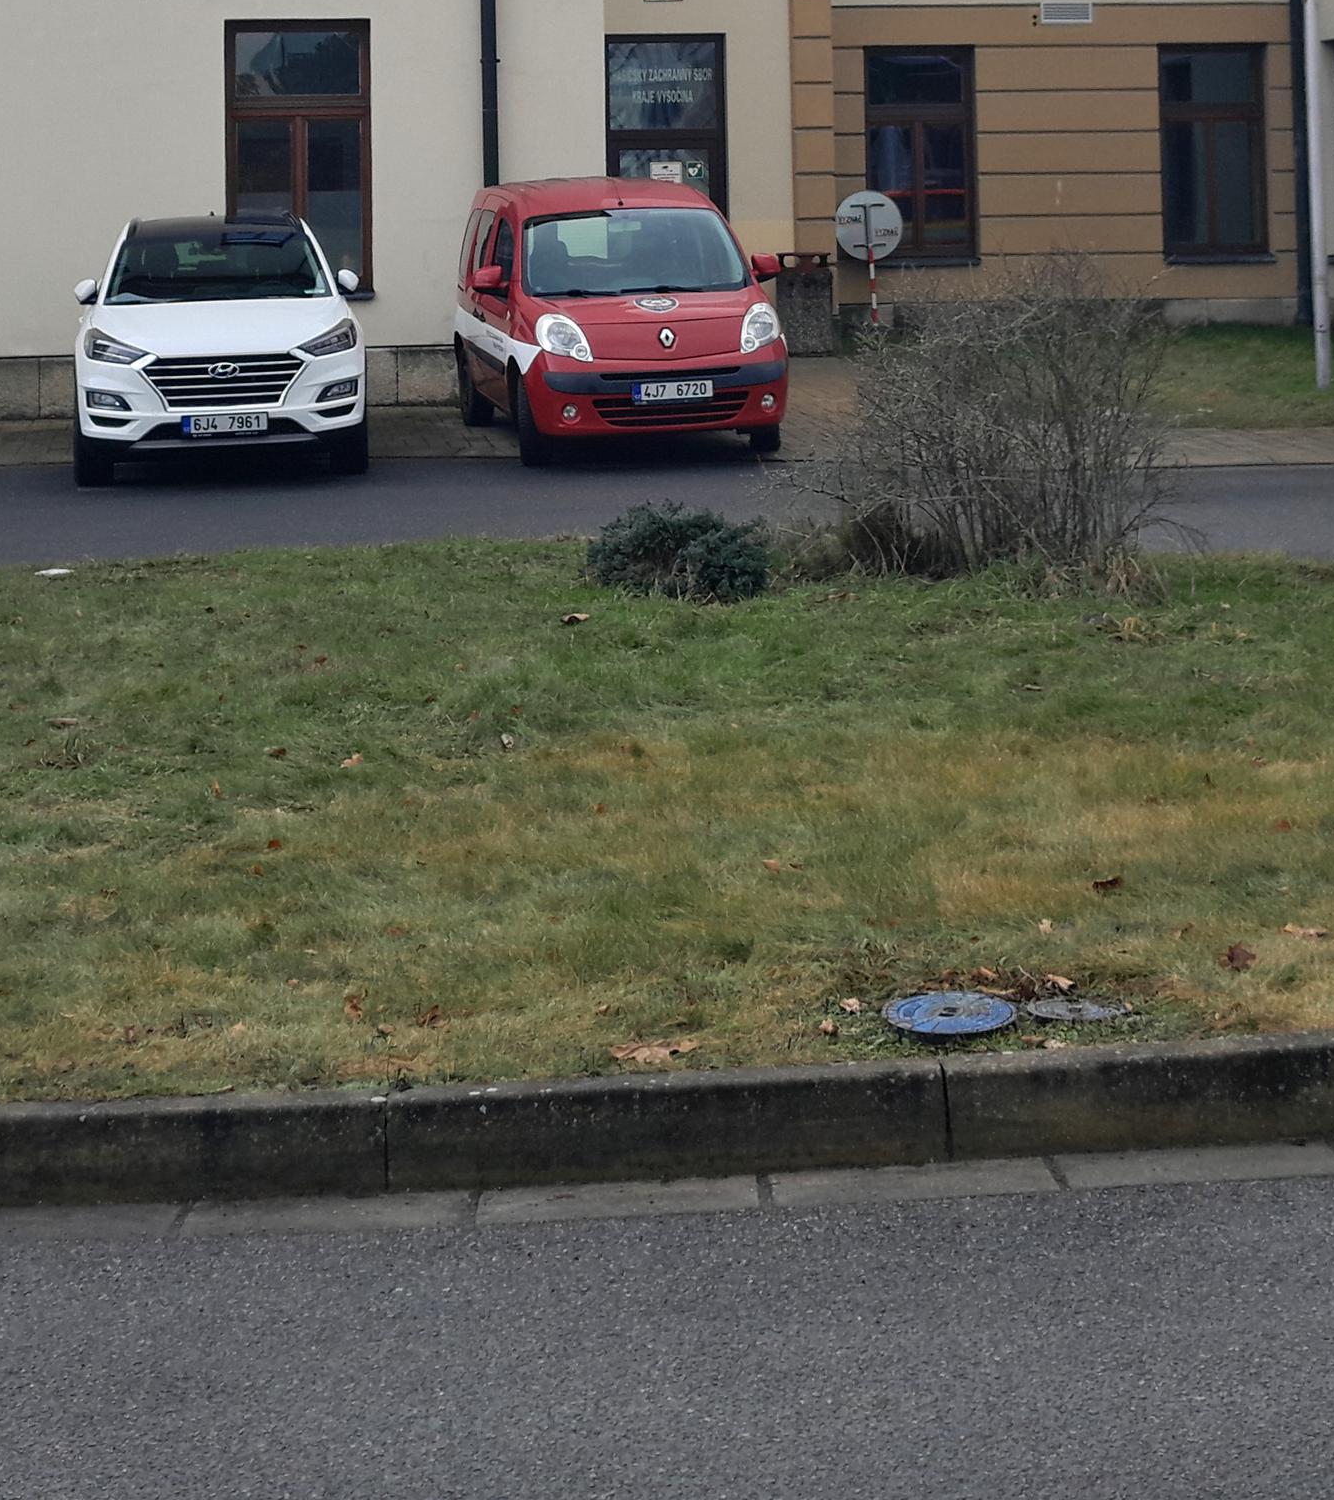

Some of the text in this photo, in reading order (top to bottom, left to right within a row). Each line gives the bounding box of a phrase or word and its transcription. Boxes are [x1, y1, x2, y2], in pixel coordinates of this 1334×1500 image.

[693, 68, 713, 81] SBOR
[632, 87, 693, 103] KRAJE VYSOČINA
[644, 385, 667, 398] 4J7
[676, 382, 707, 396] 6720
[193, 417, 218, 431] 6J4
[228, 415, 261, 429] 7961
